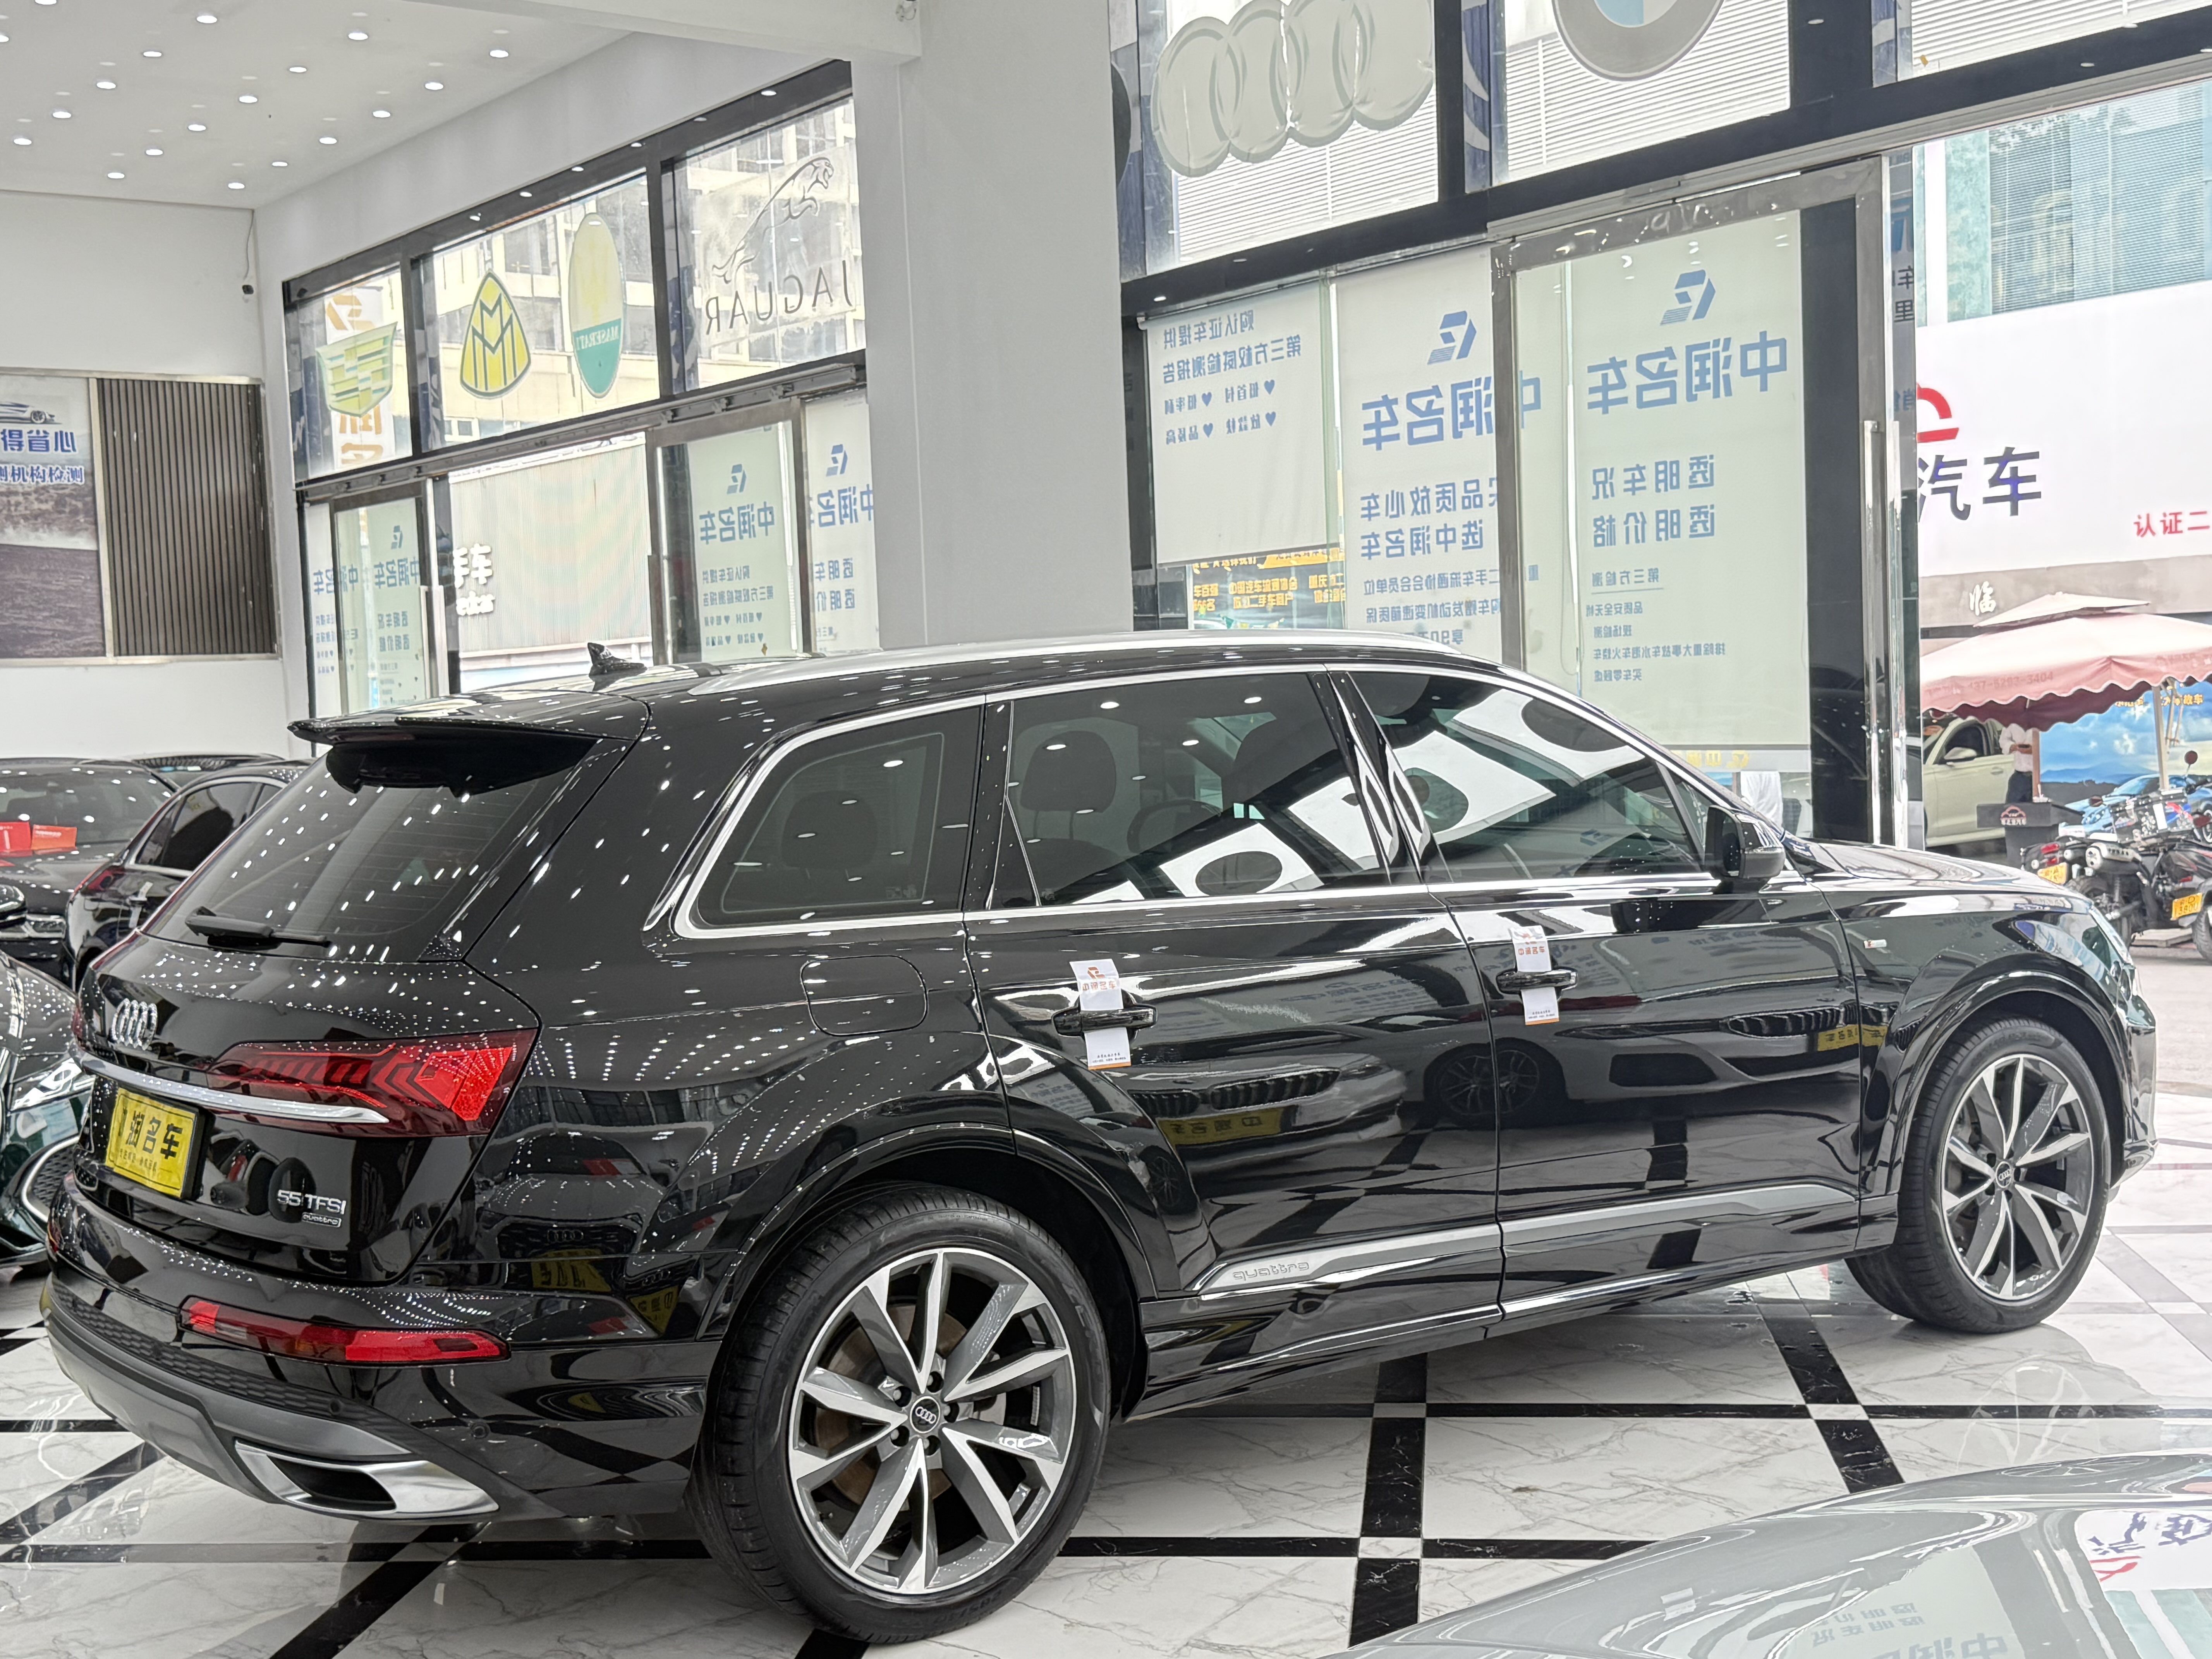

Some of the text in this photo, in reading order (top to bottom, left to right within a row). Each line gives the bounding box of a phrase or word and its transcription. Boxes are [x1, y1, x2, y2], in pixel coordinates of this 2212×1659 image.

[0, 428, 77, 453] 得省心
[1918, 446, 2042, 523] 汽车
[2133, 510, 2210, 538] 认证二
[1969, 581, 1996, 616] 临
[276, 1189, 347, 1215] 55 TFSI
[303, 1213, 339, 1225] quattro
[1233, 1262, 1310, 1281] quattro
